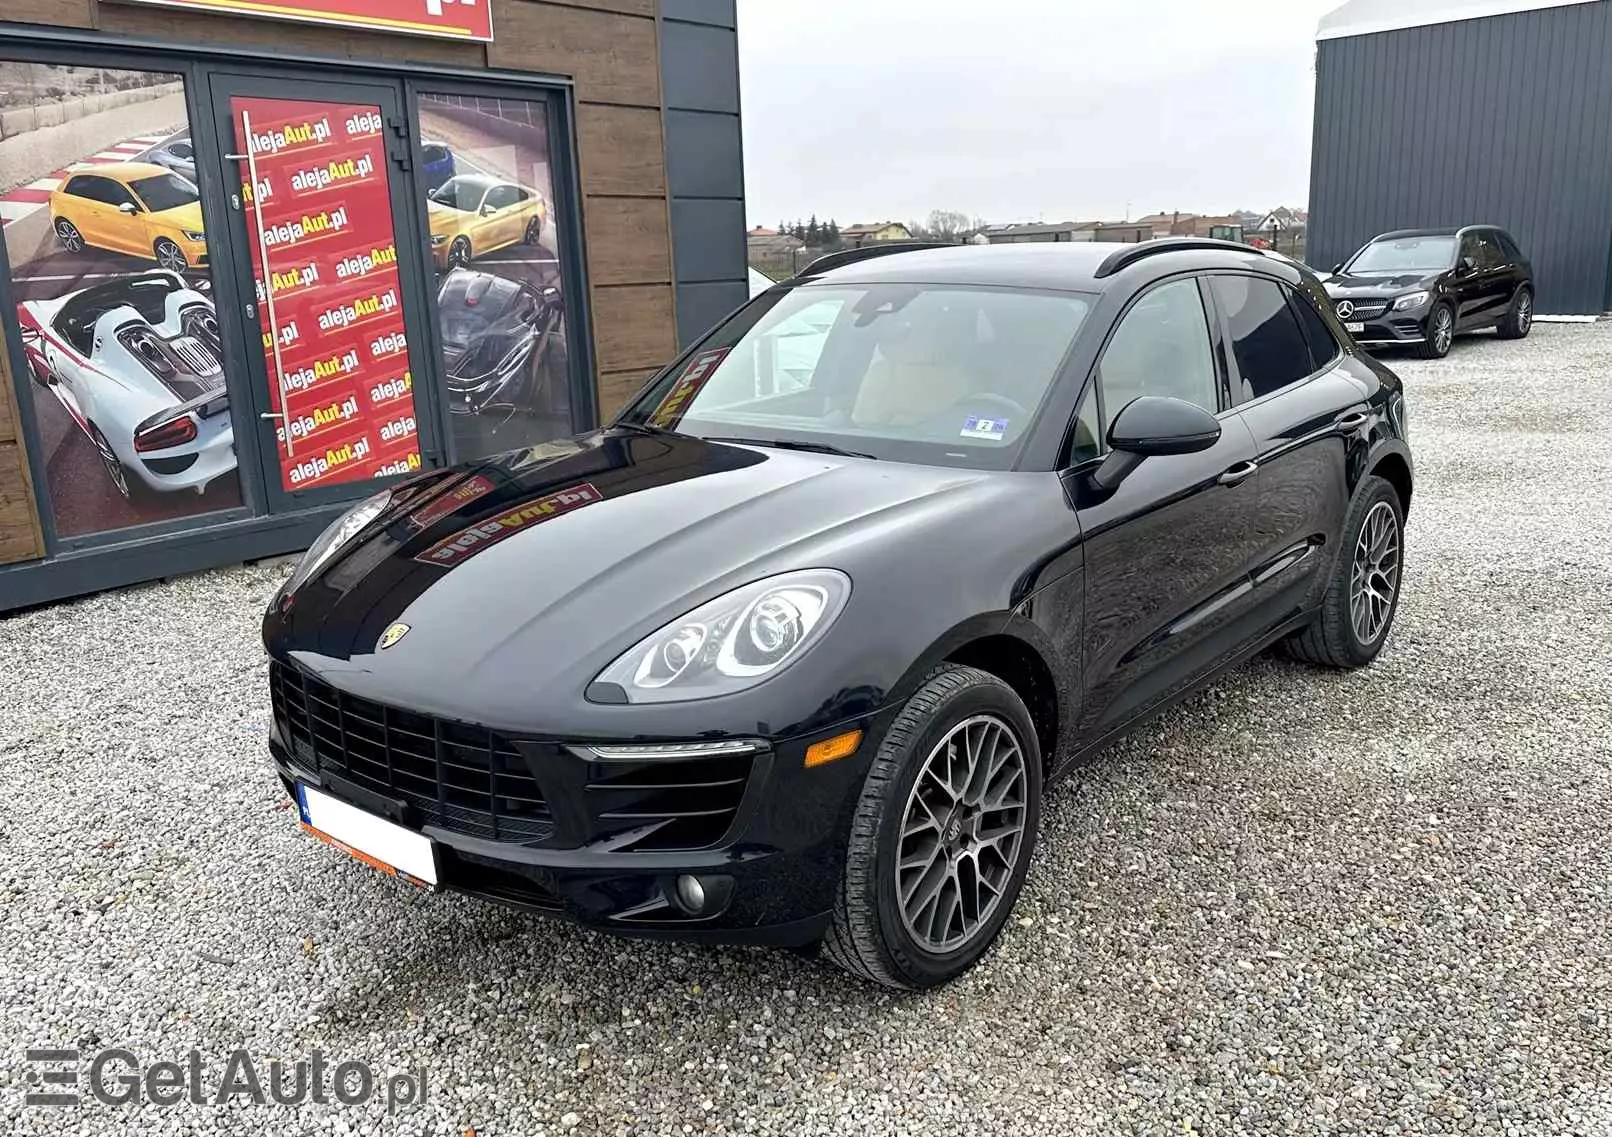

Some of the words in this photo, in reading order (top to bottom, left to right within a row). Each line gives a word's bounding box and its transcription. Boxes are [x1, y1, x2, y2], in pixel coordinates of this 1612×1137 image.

[345, 111, 382, 134] aleja
[291, 154, 373, 191] alejaAut.pl
[264, 206, 348, 246] alejaAut.pl
[335, 245, 397, 278] alejaAut
[318, 290, 398, 331] alejaAut.pl
[370, 332, 407, 356] aleja
[283, 350, 359, 392] lejaAut.pl
[275, 396, 359, 442] aejaAut.pl
[380, 416, 417, 441] aleja
[289, 437, 371, 483] alejaAut.pl
